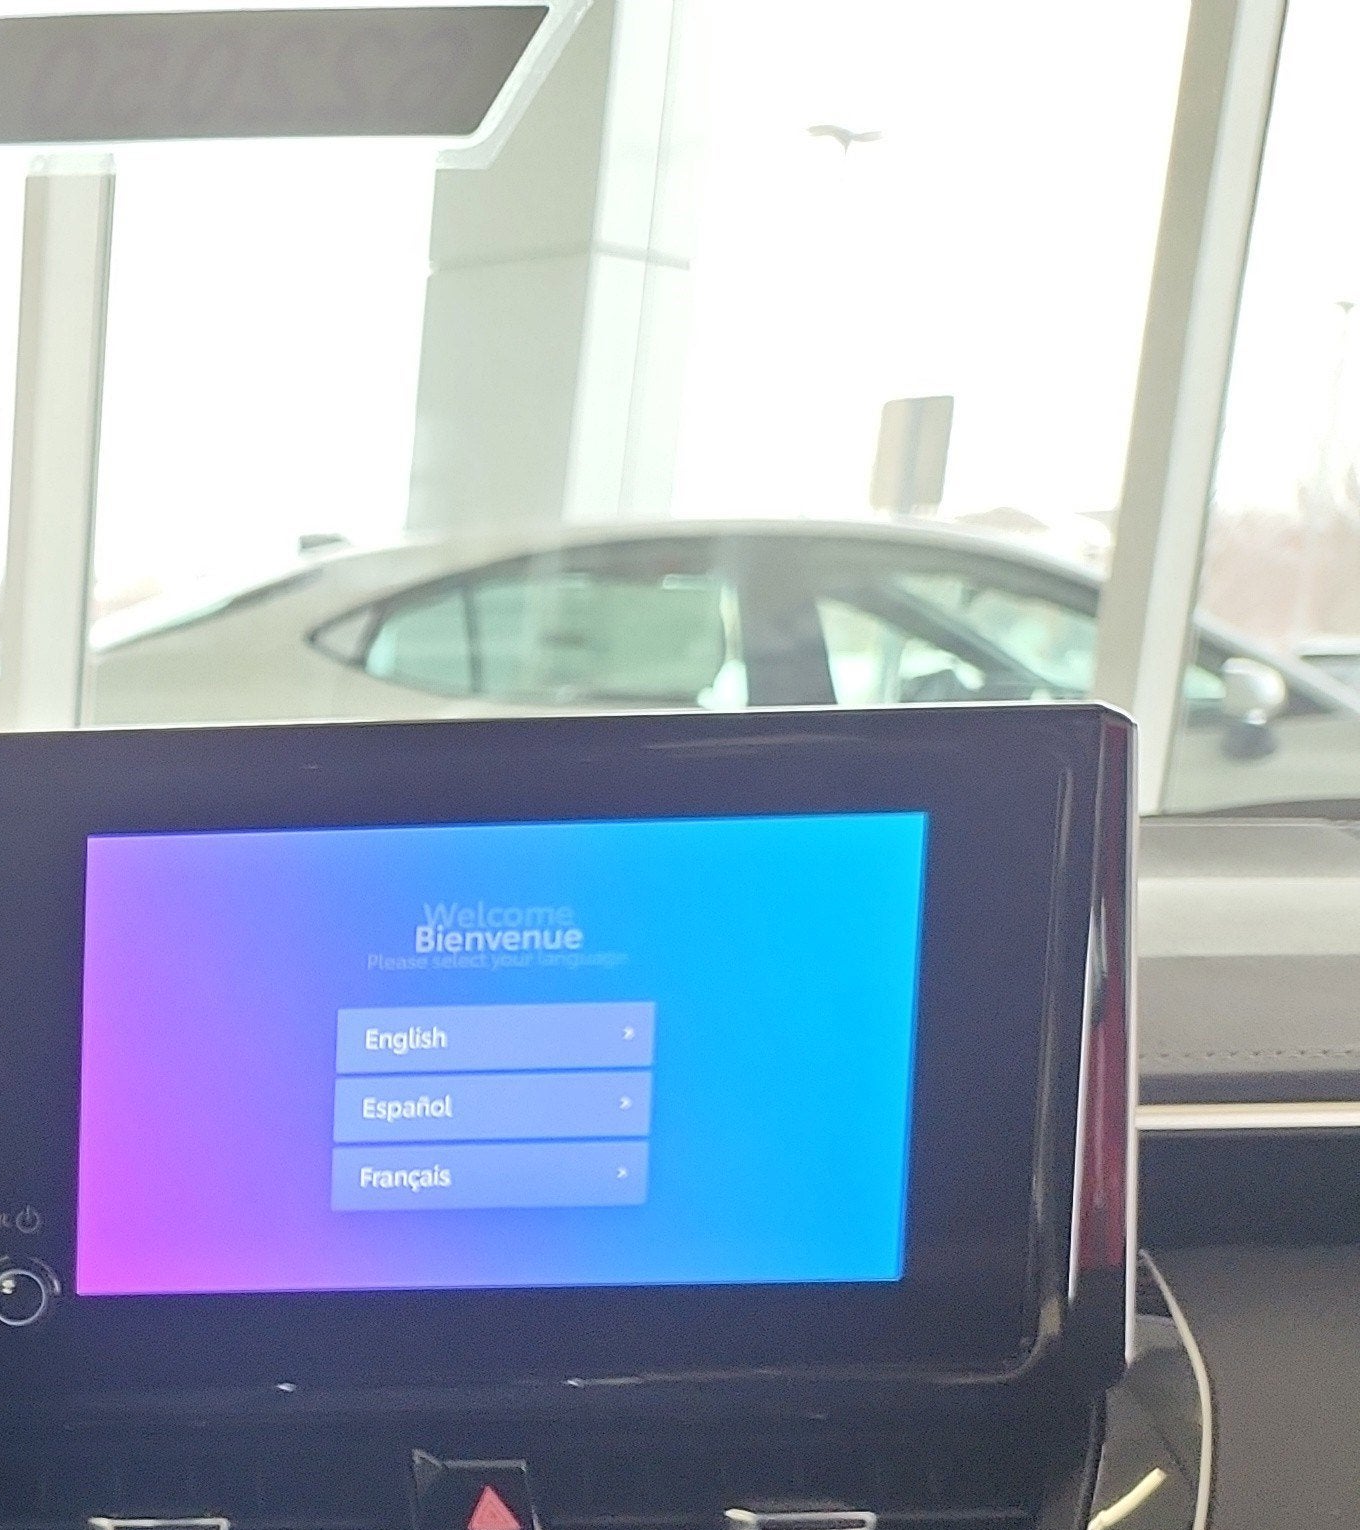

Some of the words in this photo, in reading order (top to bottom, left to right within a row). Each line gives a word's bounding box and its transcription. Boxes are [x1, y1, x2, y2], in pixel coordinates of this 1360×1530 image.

[414, 924, 584, 953] Bienvenue
[364, 1026, 448, 1055] English
[362, 1094, 453, 1123] Español
[359, 1163, 451, 1192] Français
